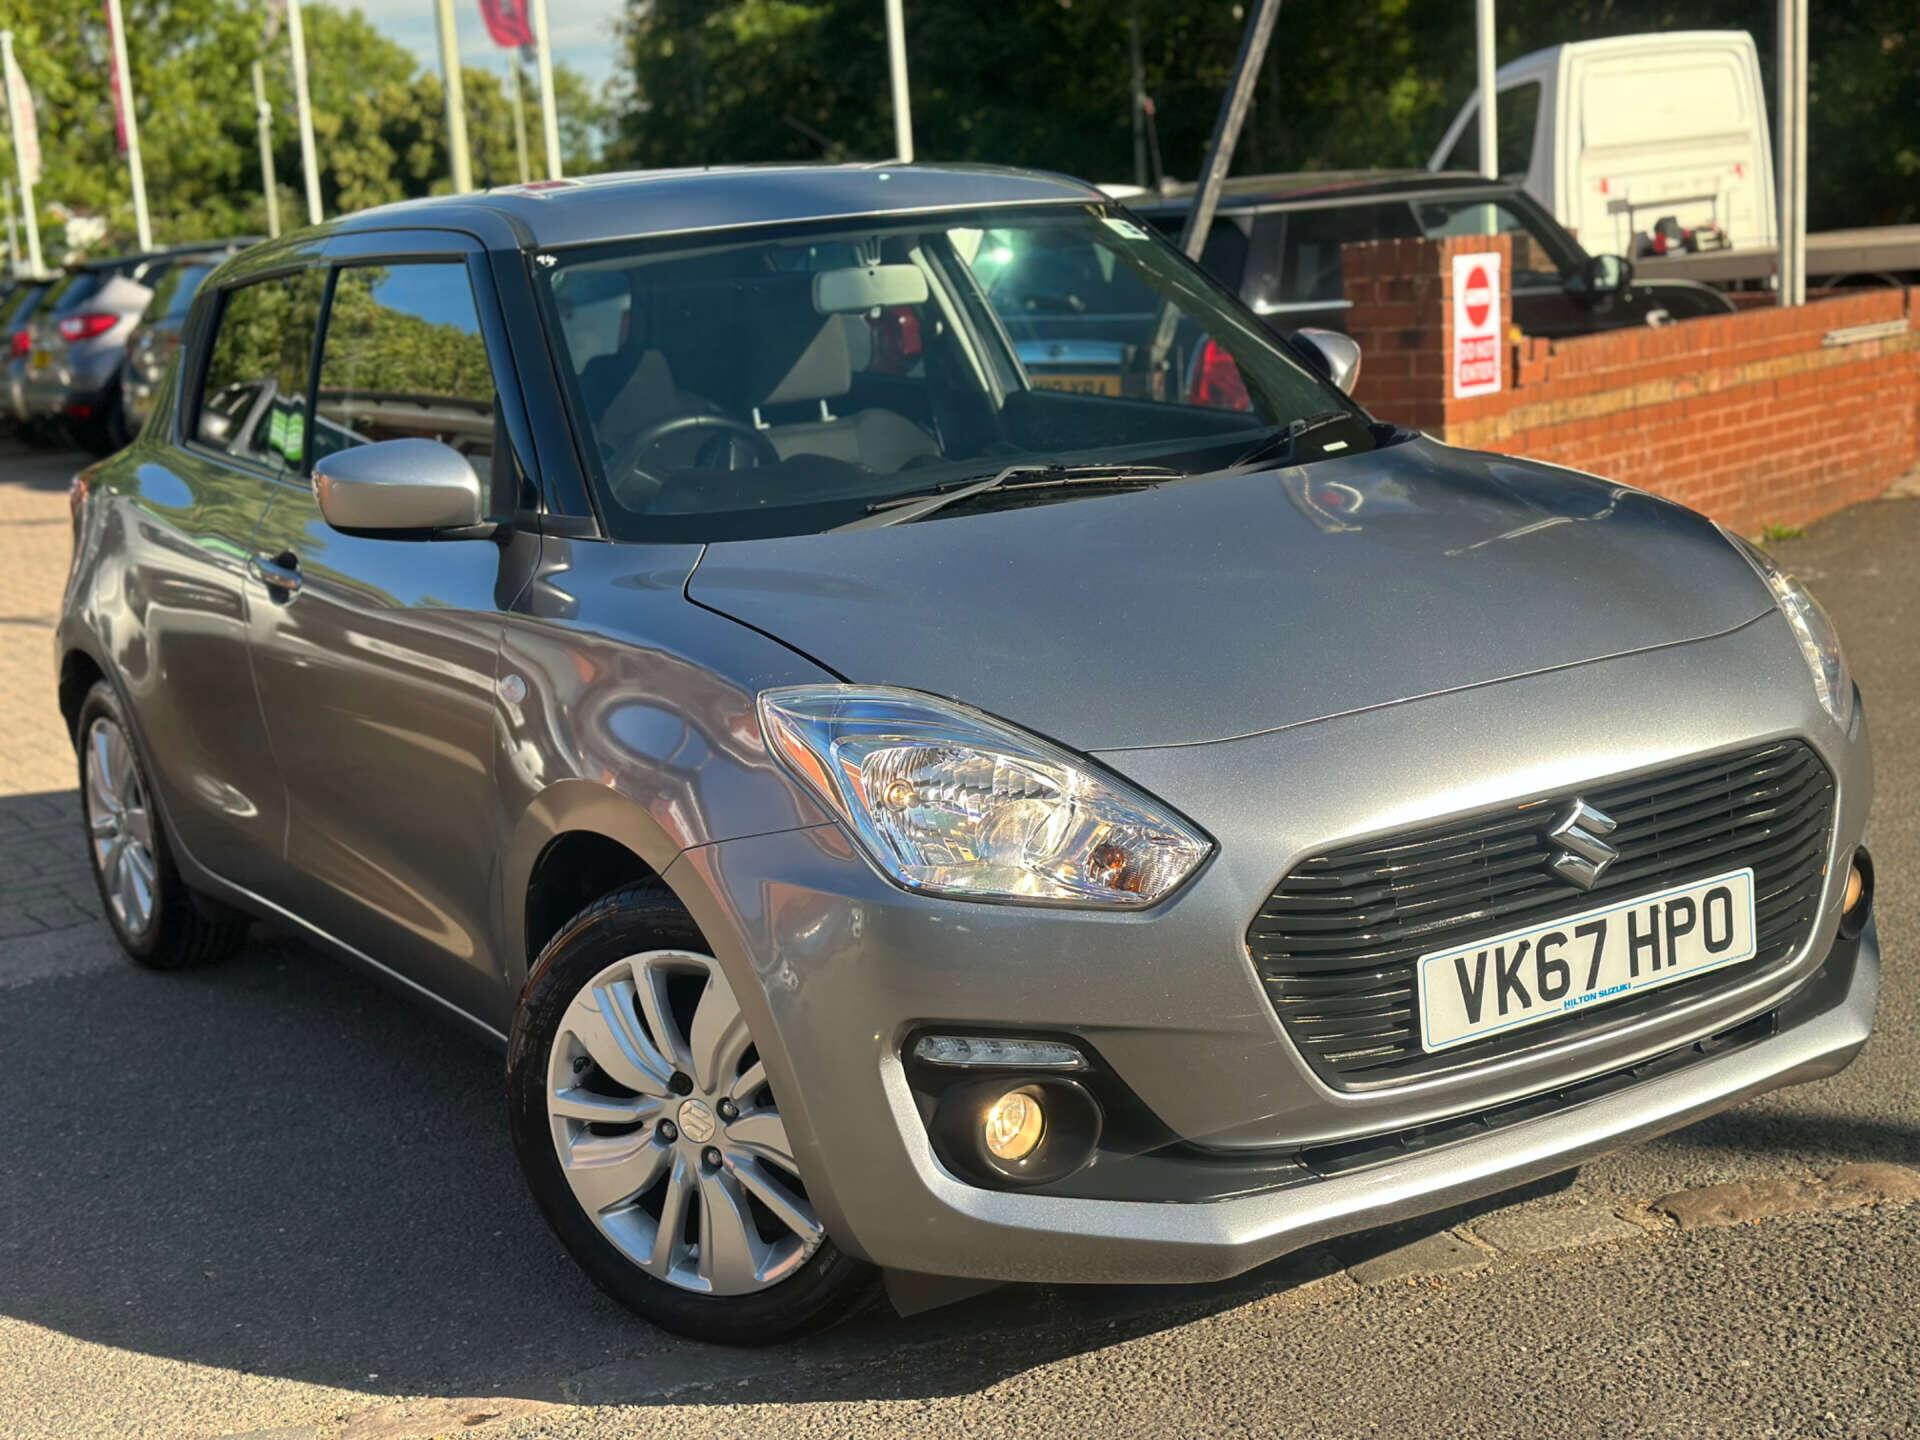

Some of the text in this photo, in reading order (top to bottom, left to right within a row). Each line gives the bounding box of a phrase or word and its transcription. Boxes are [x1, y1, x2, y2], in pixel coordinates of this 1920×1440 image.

[1454, 886, 1734, 1025] VK67 HPO
[1563, 982, 1632, 1008] HILTON SUZUKI
